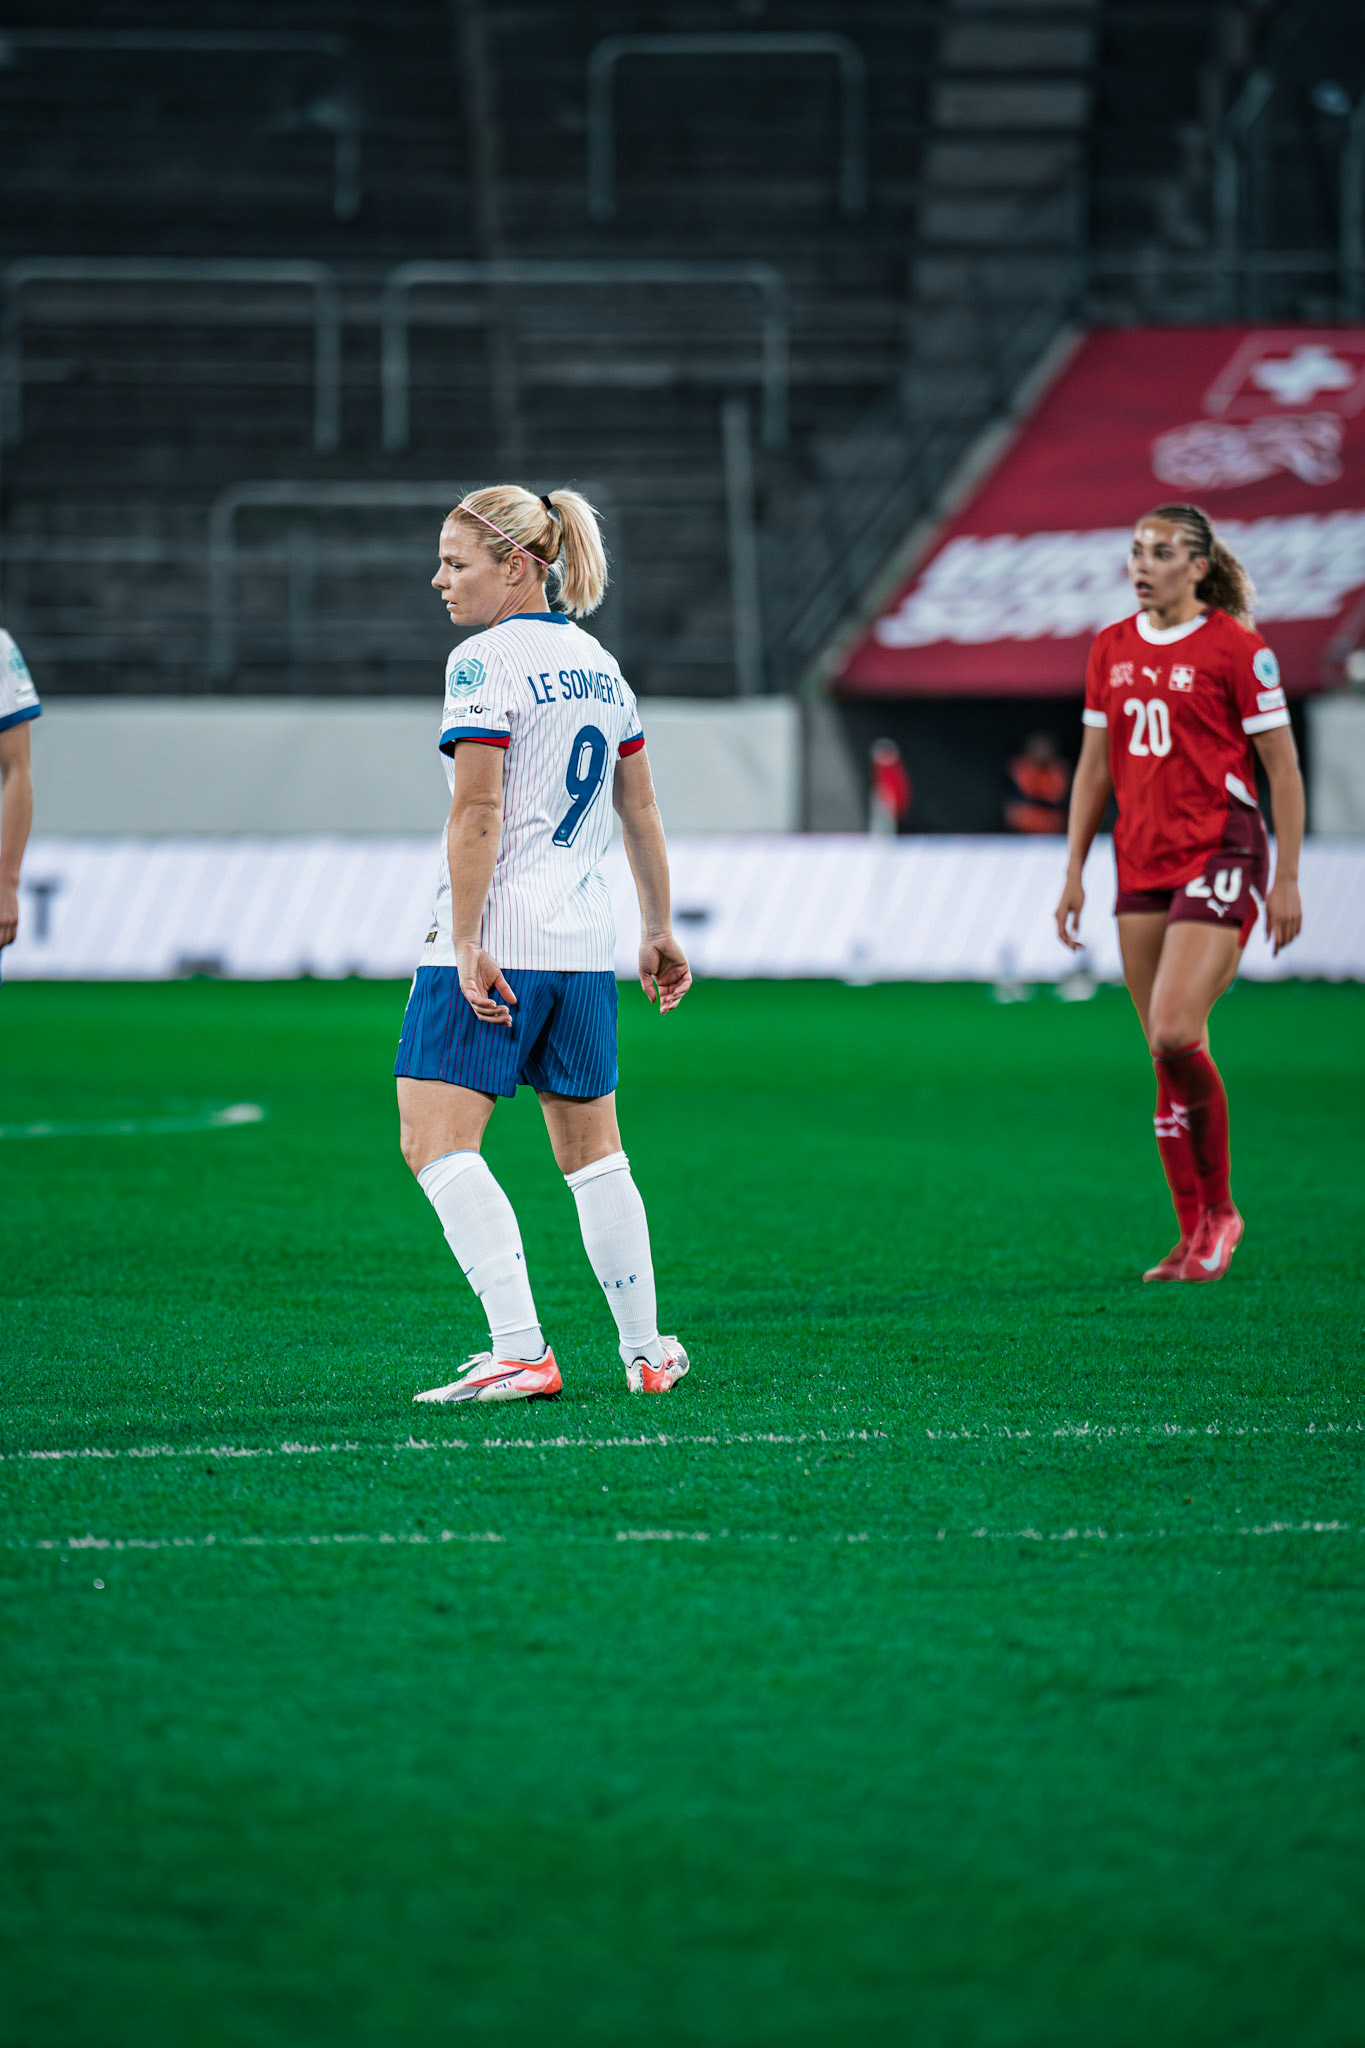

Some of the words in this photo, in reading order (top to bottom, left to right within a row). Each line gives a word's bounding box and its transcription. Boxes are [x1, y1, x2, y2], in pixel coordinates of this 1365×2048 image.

[527, 673, 556, 704] LE
[558, 669, 616, 705] SOMMER
[1123, 698, 1172, 757] 20
[552, 725, 609, 848] 9
